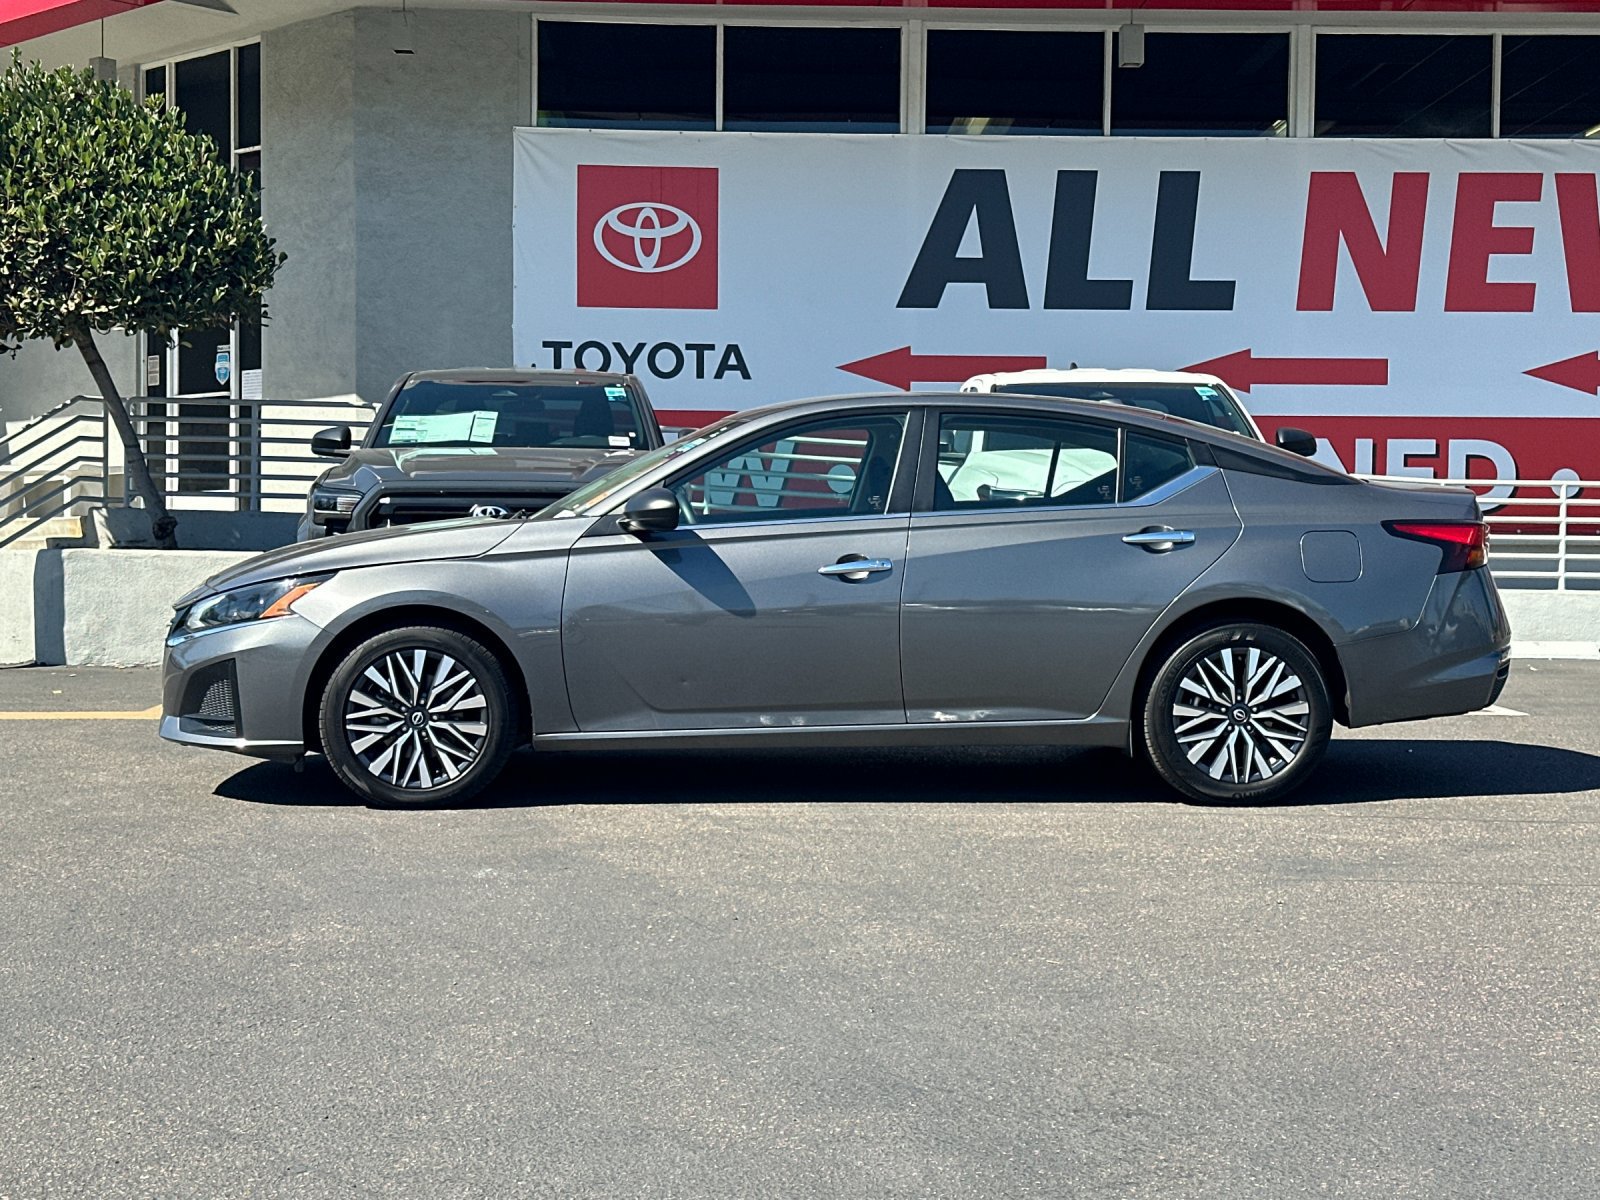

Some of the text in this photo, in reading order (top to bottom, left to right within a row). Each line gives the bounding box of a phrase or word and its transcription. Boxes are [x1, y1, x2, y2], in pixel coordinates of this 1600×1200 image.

[896, 169, 1600, 312] ALL NE
[542, 340, 752, 380] TOYOTA
